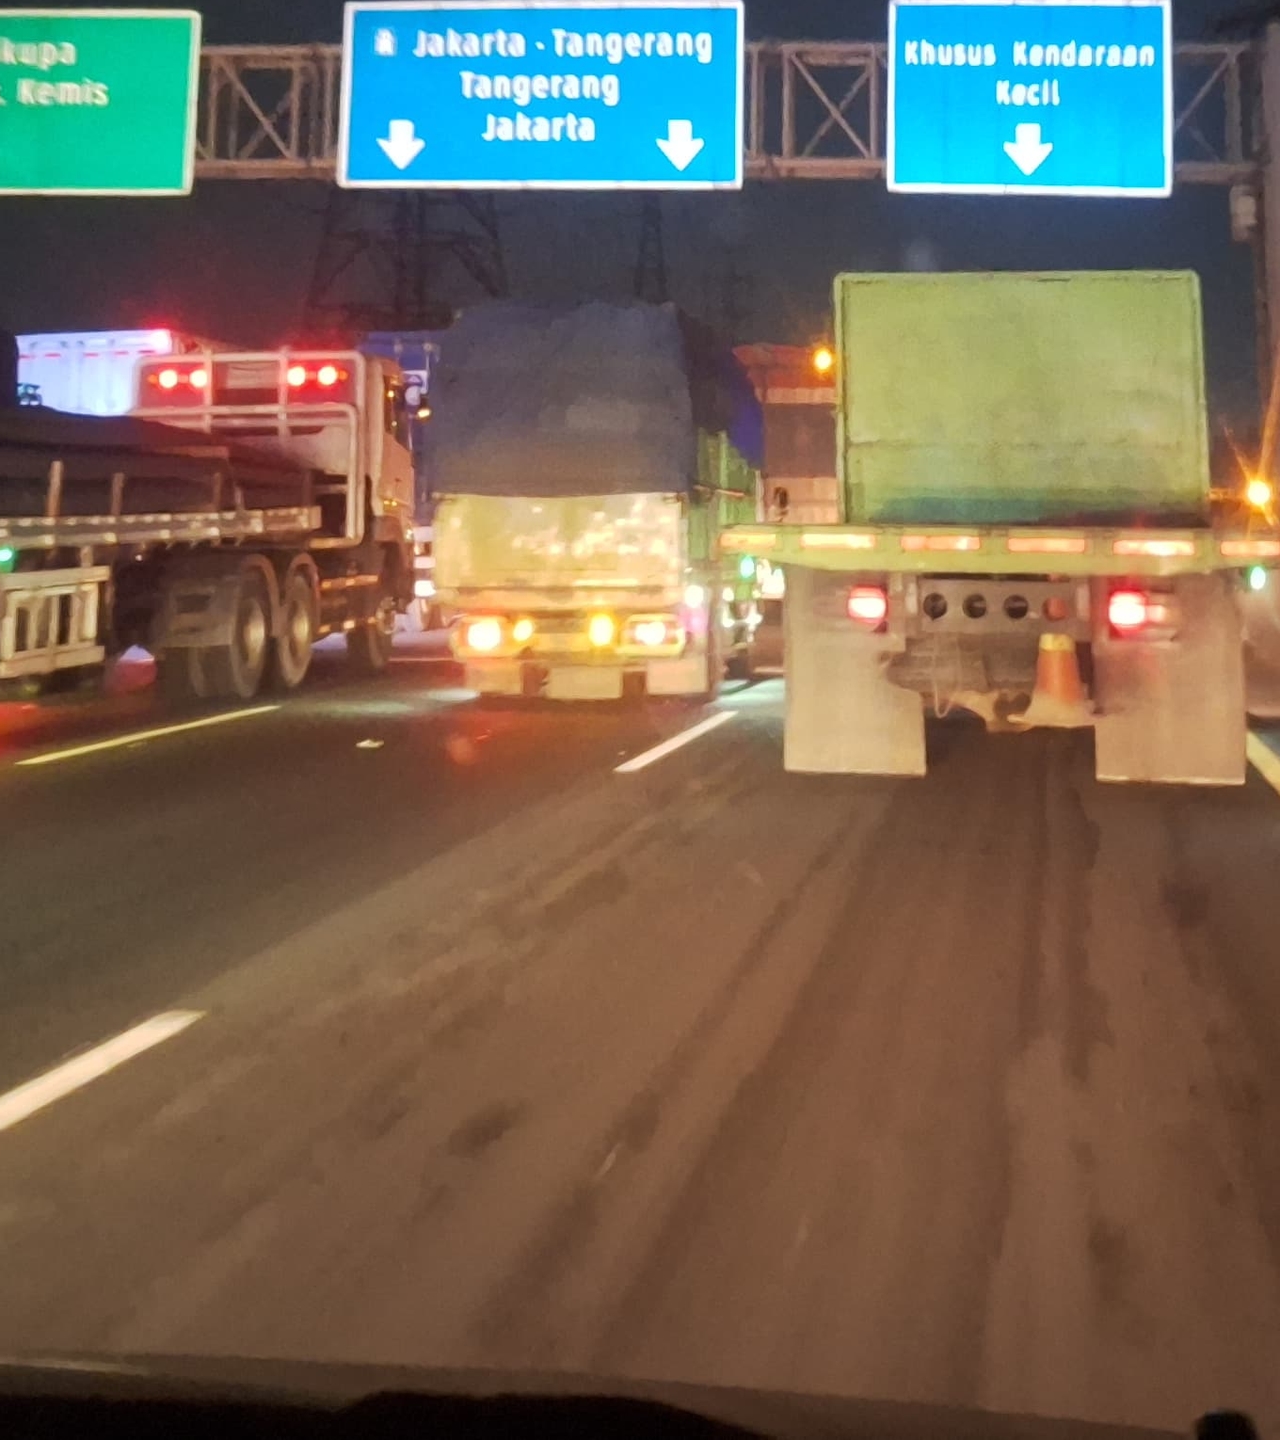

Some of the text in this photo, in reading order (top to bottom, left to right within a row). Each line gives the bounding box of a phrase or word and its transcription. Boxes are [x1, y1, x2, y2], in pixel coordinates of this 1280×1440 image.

[414, 29, 526, 57] Jakarta
[552, 29, 713, 64] Tangerang
[904, 39, 1155, 67] Khusus Kendaraan
[17, 77, 110, 107] Kemis
[460, 70, 620, 106] Tangerang
[996, 79, 1060, 106] Kecil
[482, 112, 595, 141] Jakarta
